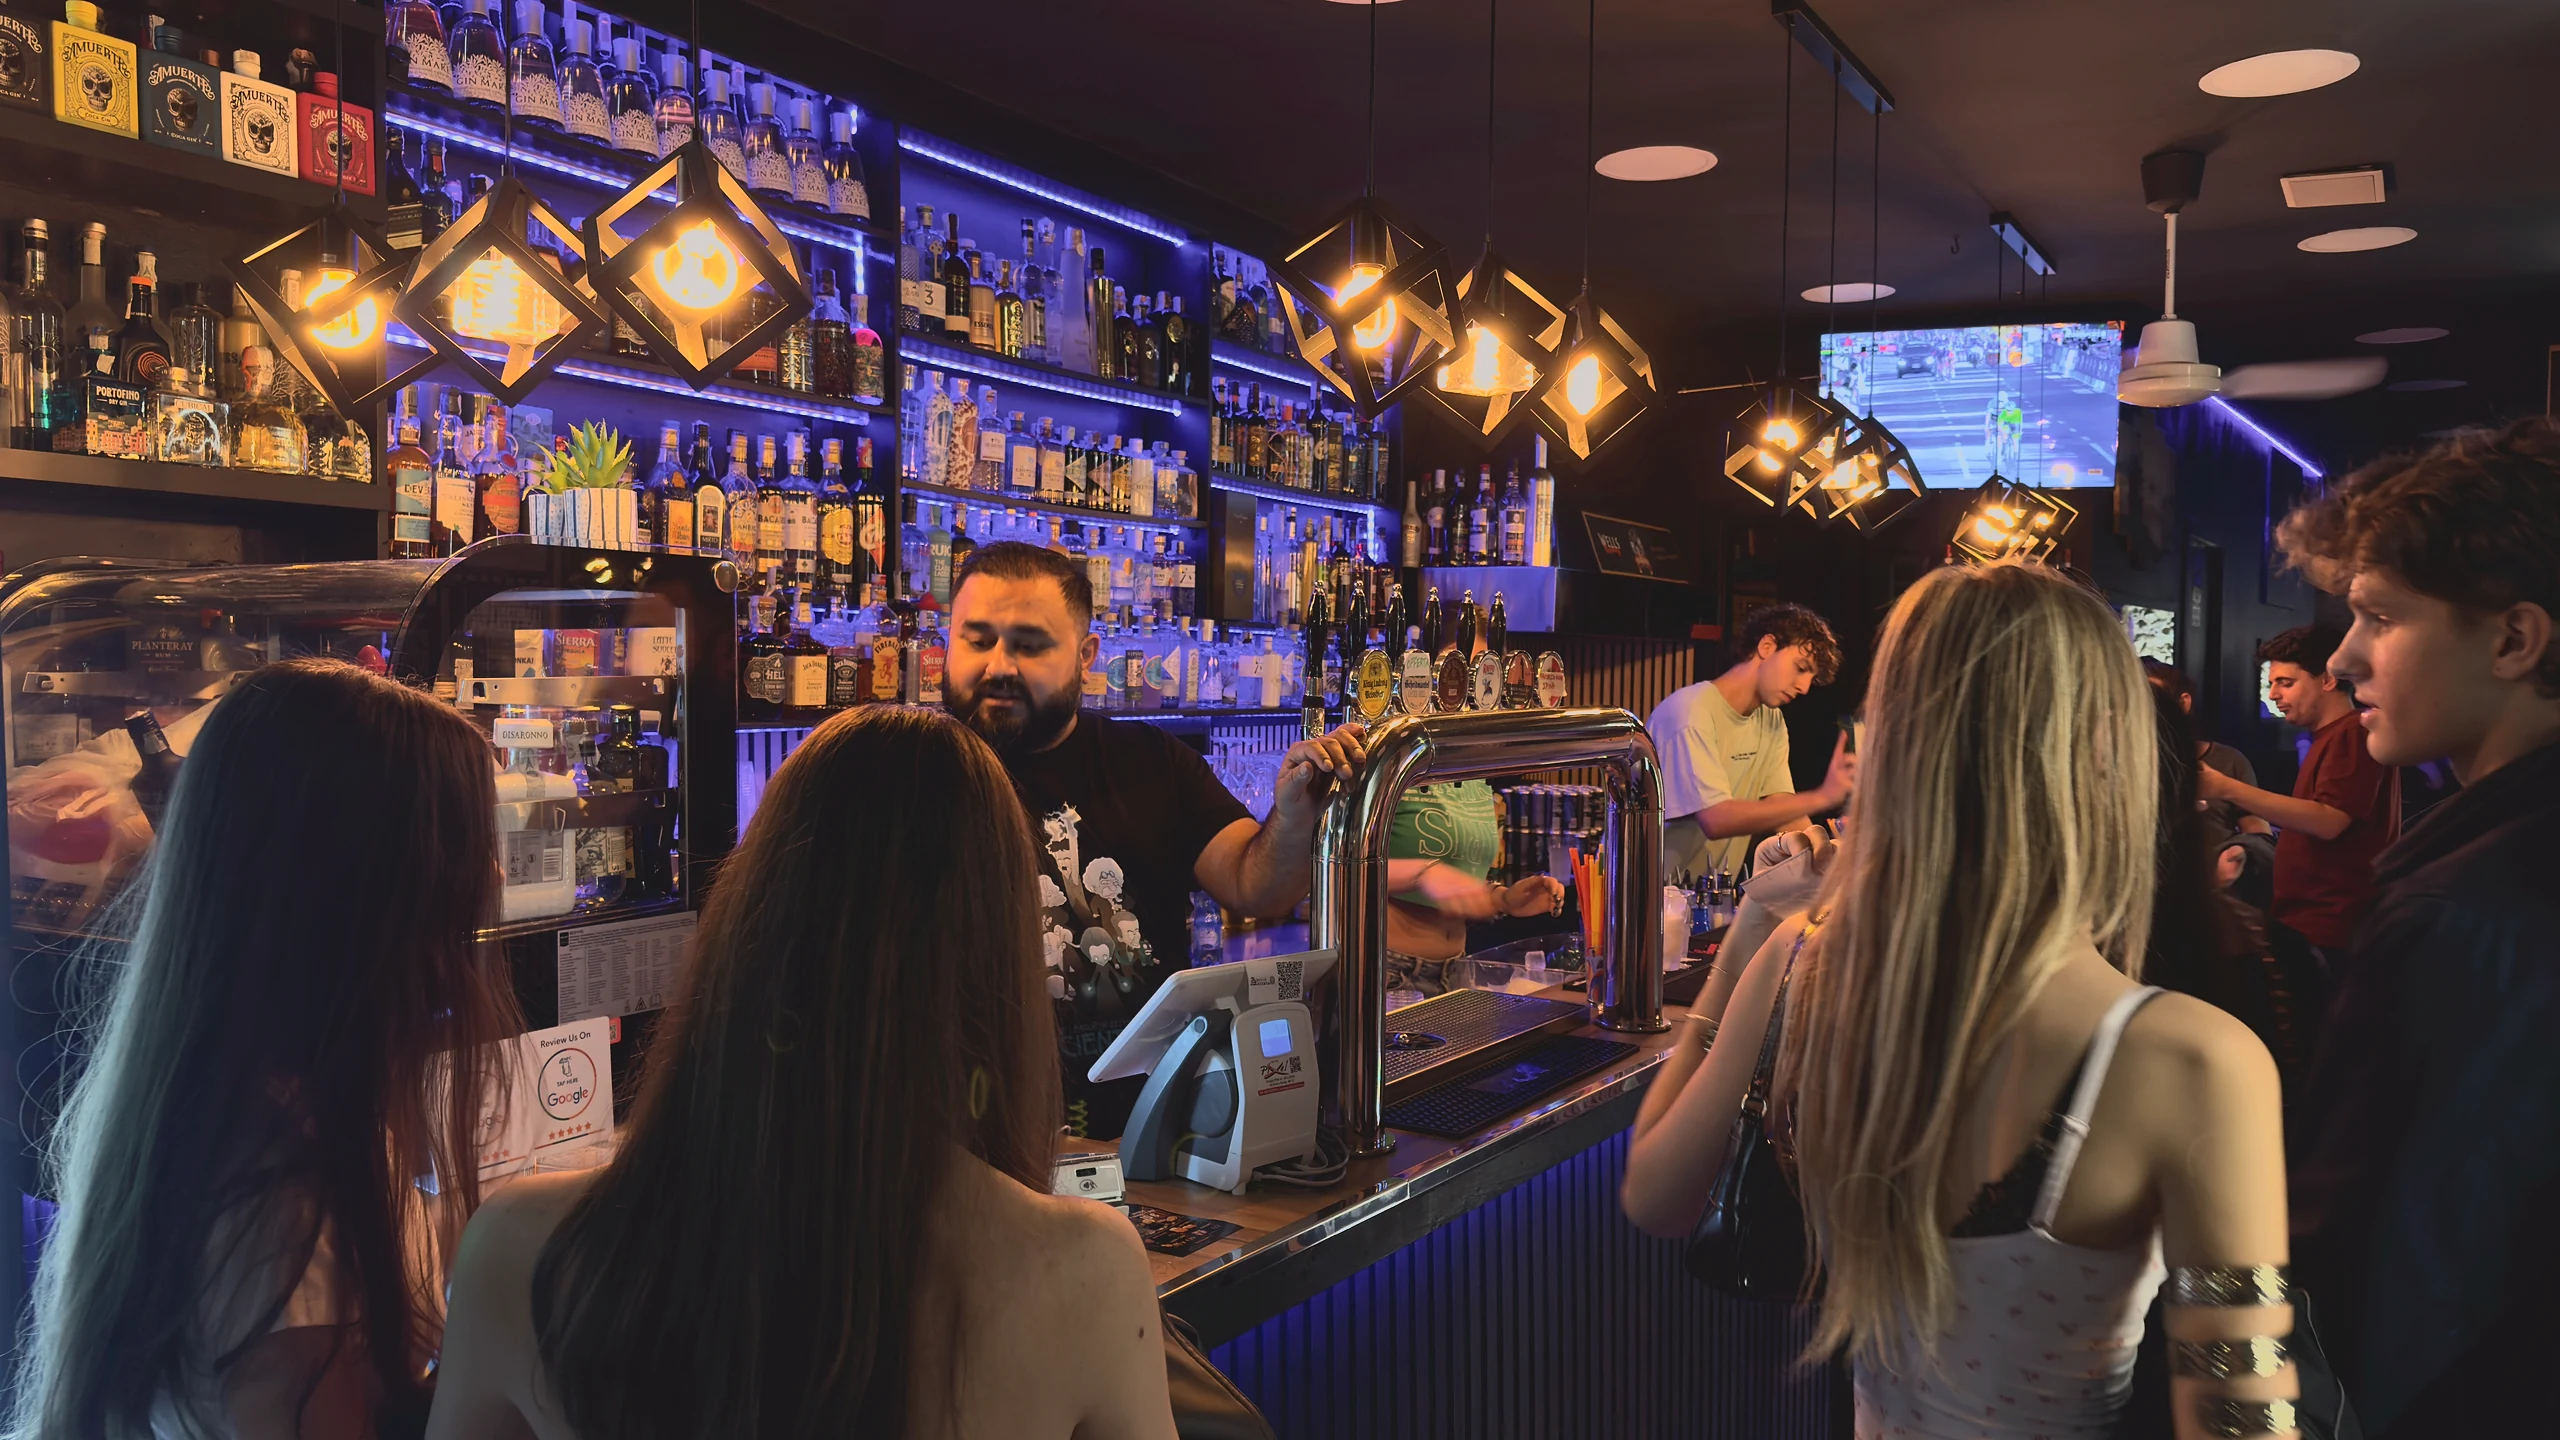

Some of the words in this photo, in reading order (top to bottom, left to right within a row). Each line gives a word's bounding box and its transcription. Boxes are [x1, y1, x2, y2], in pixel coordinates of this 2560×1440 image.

[62, 41, 131, 79] AMUERTE
[148, 65, 215, 100] AMUERTE
[456, 77, 477, 85] GIN
[230, 90, 290, 123] AMUERTE
[516, 95, 535, 103] GIN
[565, 114, 583, 122] GIN
[614, 130, 633, 138] GIN
[924, 289, 934, 305] 3
[96, 386, 140, 401] PORTOFINO
[1597, 532, 1621, 550] WELLS
[132, 641, 193, 651] PLANTERAY
[556, 632, 596, 647] SIERRA
[502, 730, 549, 740] DISARONNO
[540, 1037, 567, 1048] Review
[568, 1034, 578, 1042] Us
[579, 1031, 591, 1039] On
[566, 1077, 579, 1085] HERE
[547, 1086, 589, 1107] Google
